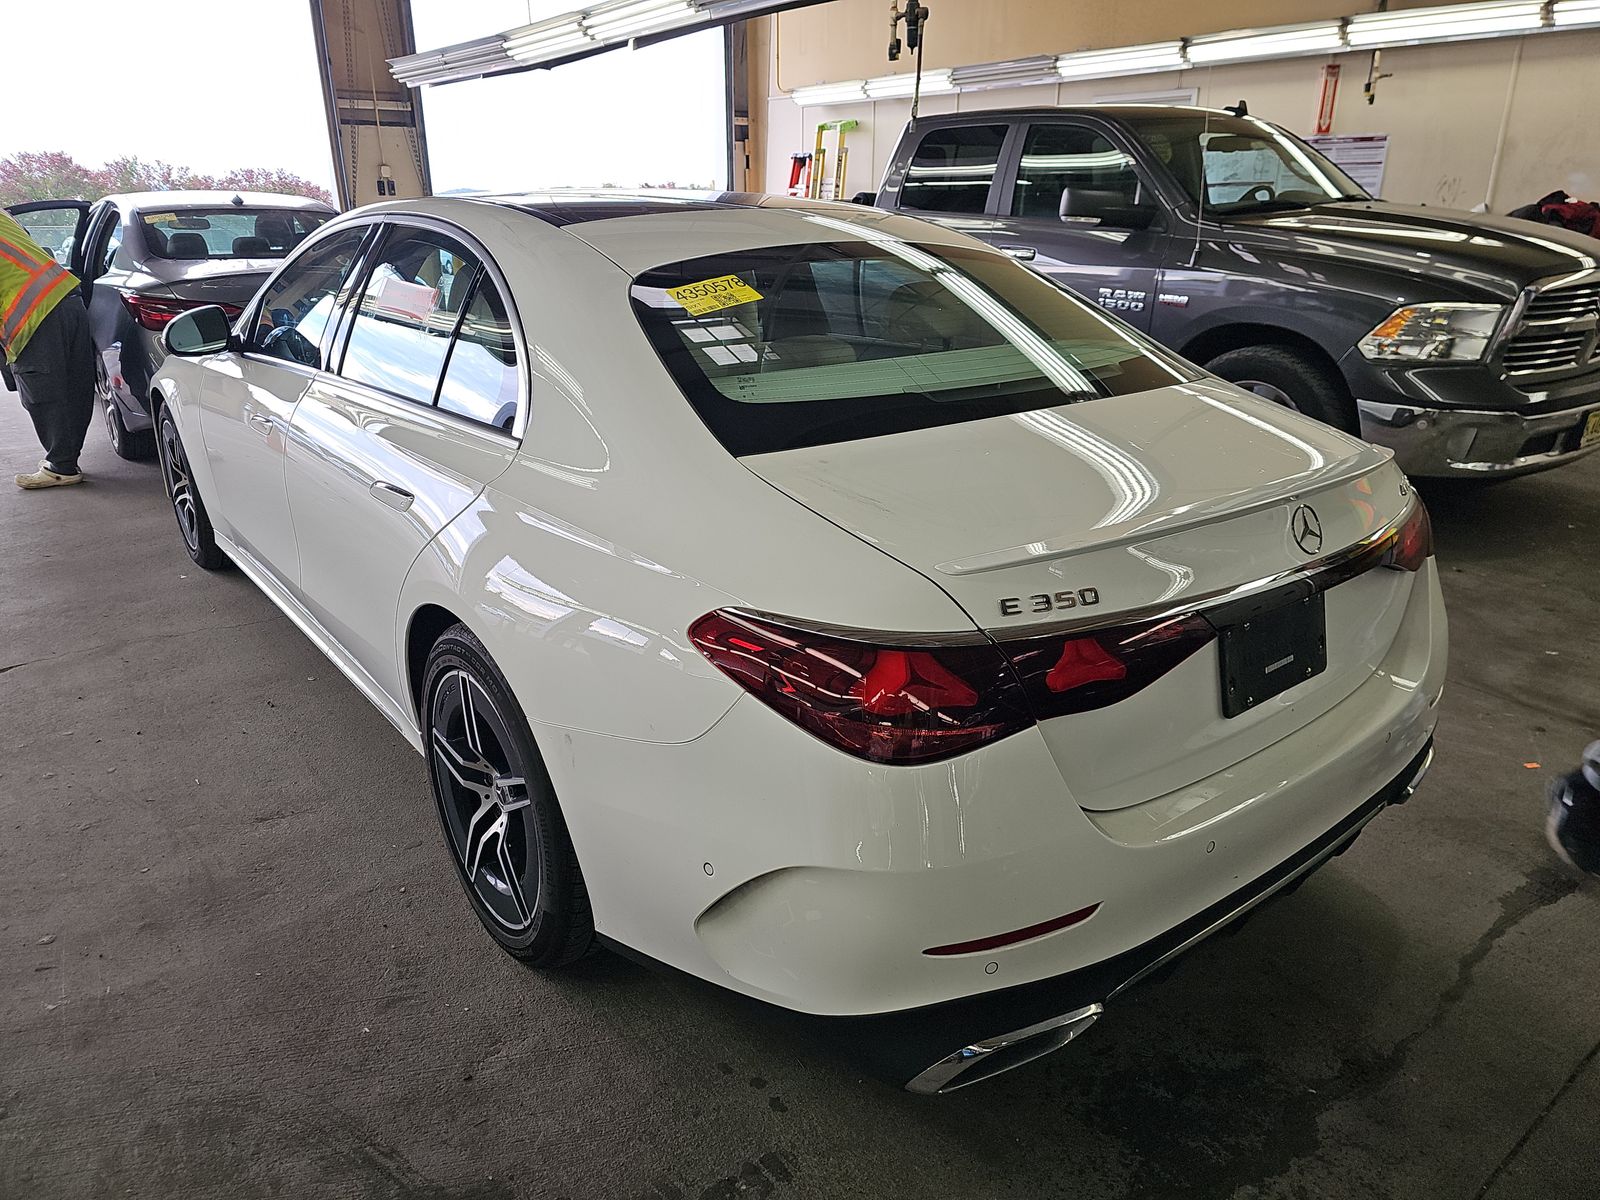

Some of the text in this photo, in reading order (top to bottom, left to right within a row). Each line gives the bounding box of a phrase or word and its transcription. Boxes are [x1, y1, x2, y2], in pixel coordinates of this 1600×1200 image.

[676, 278, 746, 300] 4350578
[1098, 297, 1144, 312] 1500
[999, 587, 1100, 617] E 350
